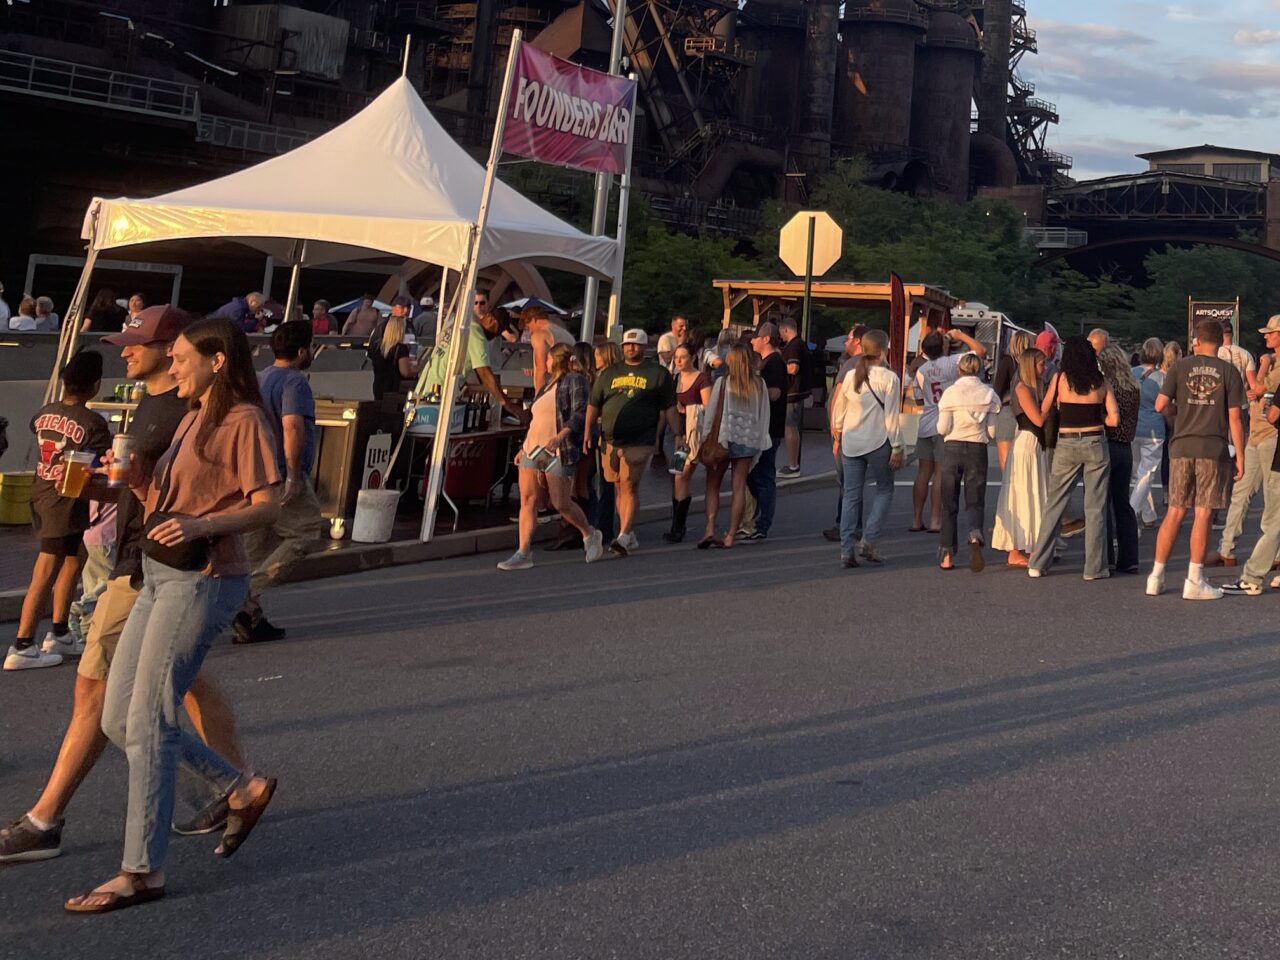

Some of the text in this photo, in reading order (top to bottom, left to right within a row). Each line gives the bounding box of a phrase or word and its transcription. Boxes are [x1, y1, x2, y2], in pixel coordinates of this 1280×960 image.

[513, 77, 630, 145] FOUNDERS BAR
[931, 381, 943, 404] 5
[367, 447, 389, 469] Lite
